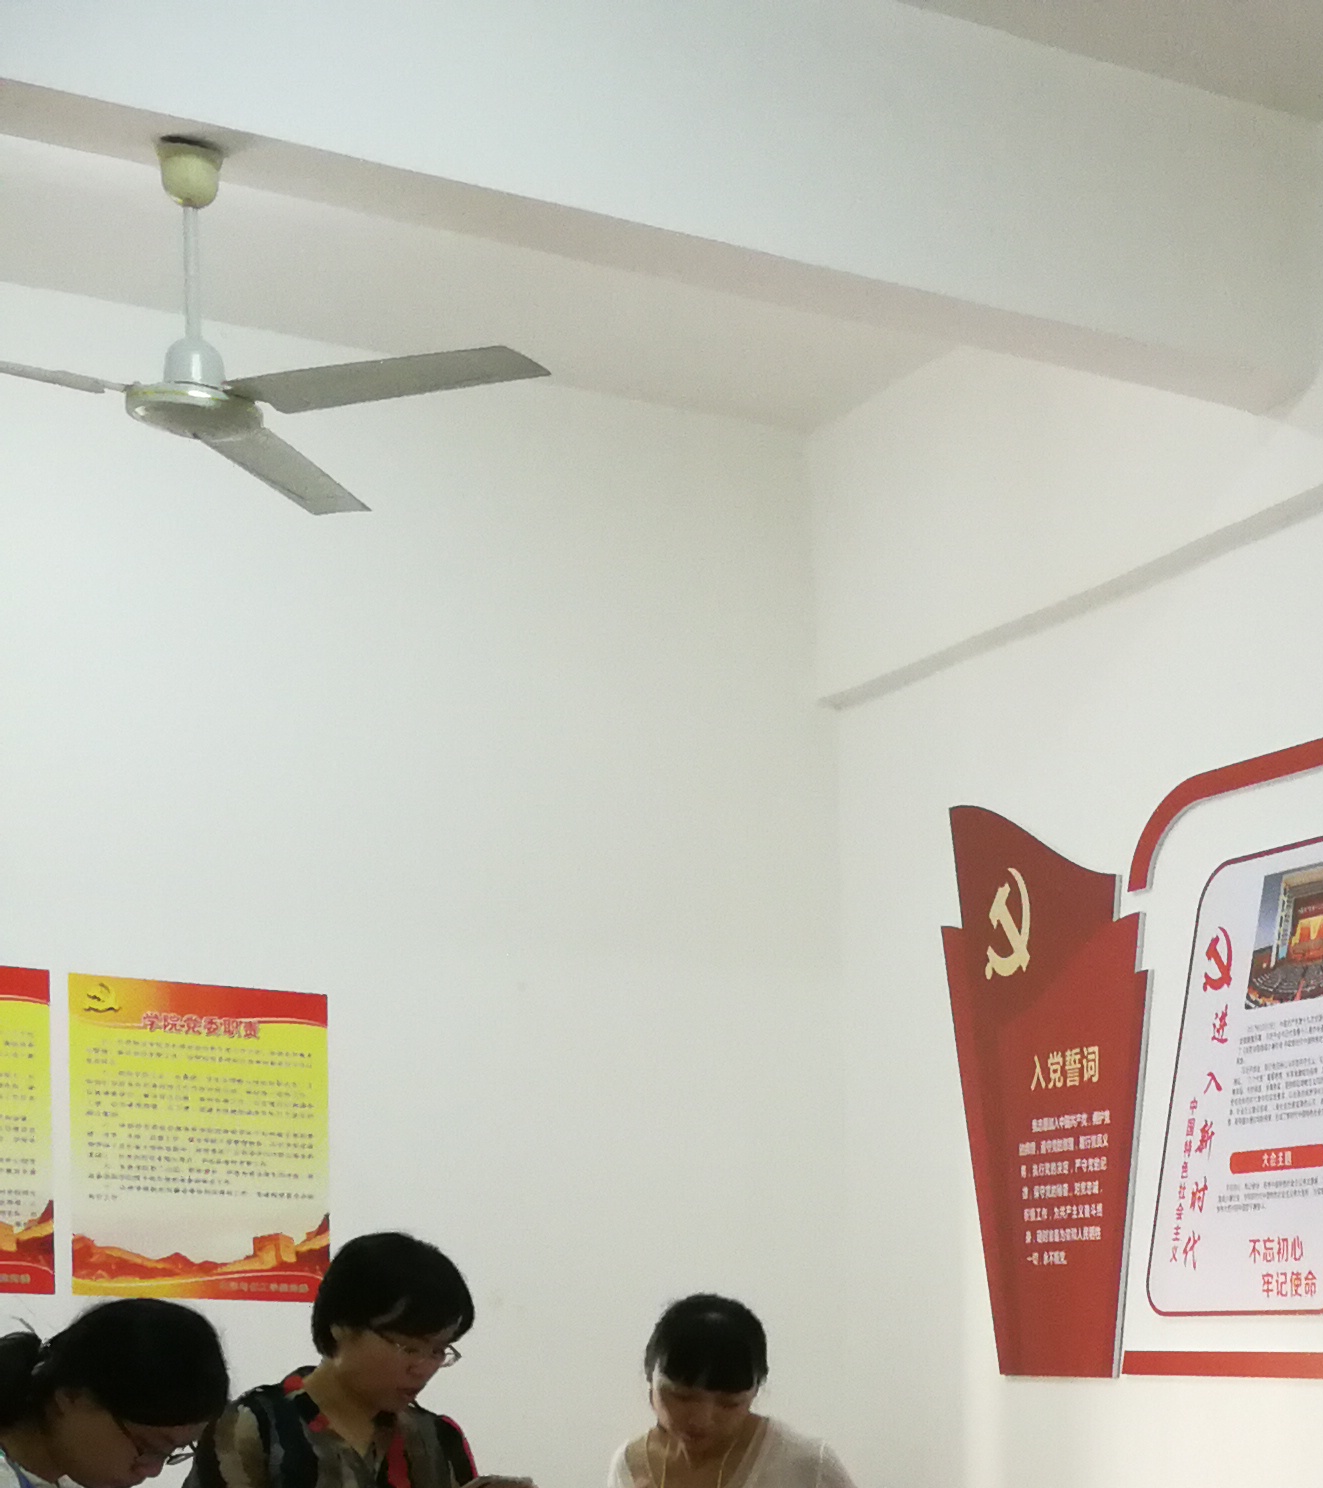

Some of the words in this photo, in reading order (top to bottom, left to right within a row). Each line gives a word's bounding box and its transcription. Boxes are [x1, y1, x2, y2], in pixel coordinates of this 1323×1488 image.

[1030, 1046, 1099, 1091] 入党誓词
[1249, 1236, 1304, 1264] 不忘初心
[1262, 1271, 1317, 1298] 牢记使命
